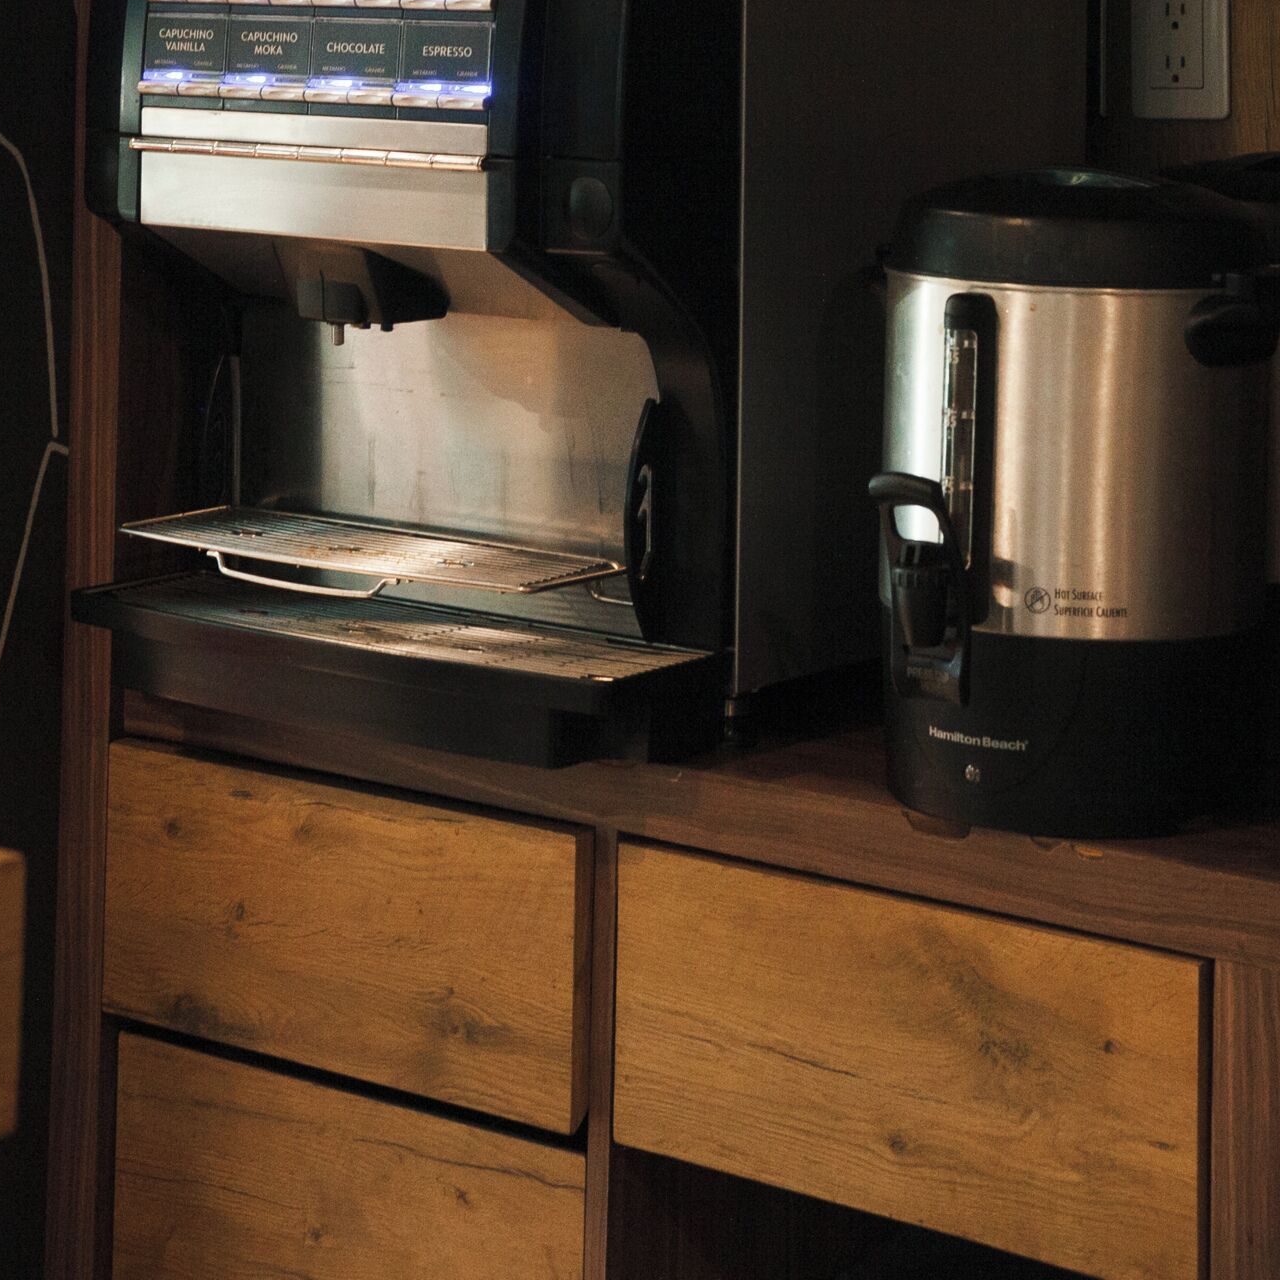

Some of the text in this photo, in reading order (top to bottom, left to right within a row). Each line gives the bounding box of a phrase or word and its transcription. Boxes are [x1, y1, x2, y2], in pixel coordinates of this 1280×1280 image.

[159, 28, 214, 40] CAPUCHINO
[241, 31, 298, 43] CAPUCHINO
[165, 41, 206, 52] VAINILLA
[254, 45, 283, 56] MOKA
[326, 42, 385, 55] CHOCOLATE
[422, 45, 473, 58] ESPRESSO
[1054, 587, 1070, 600] HOT
[928, 725, 1026, 751] Hamilton Beach
